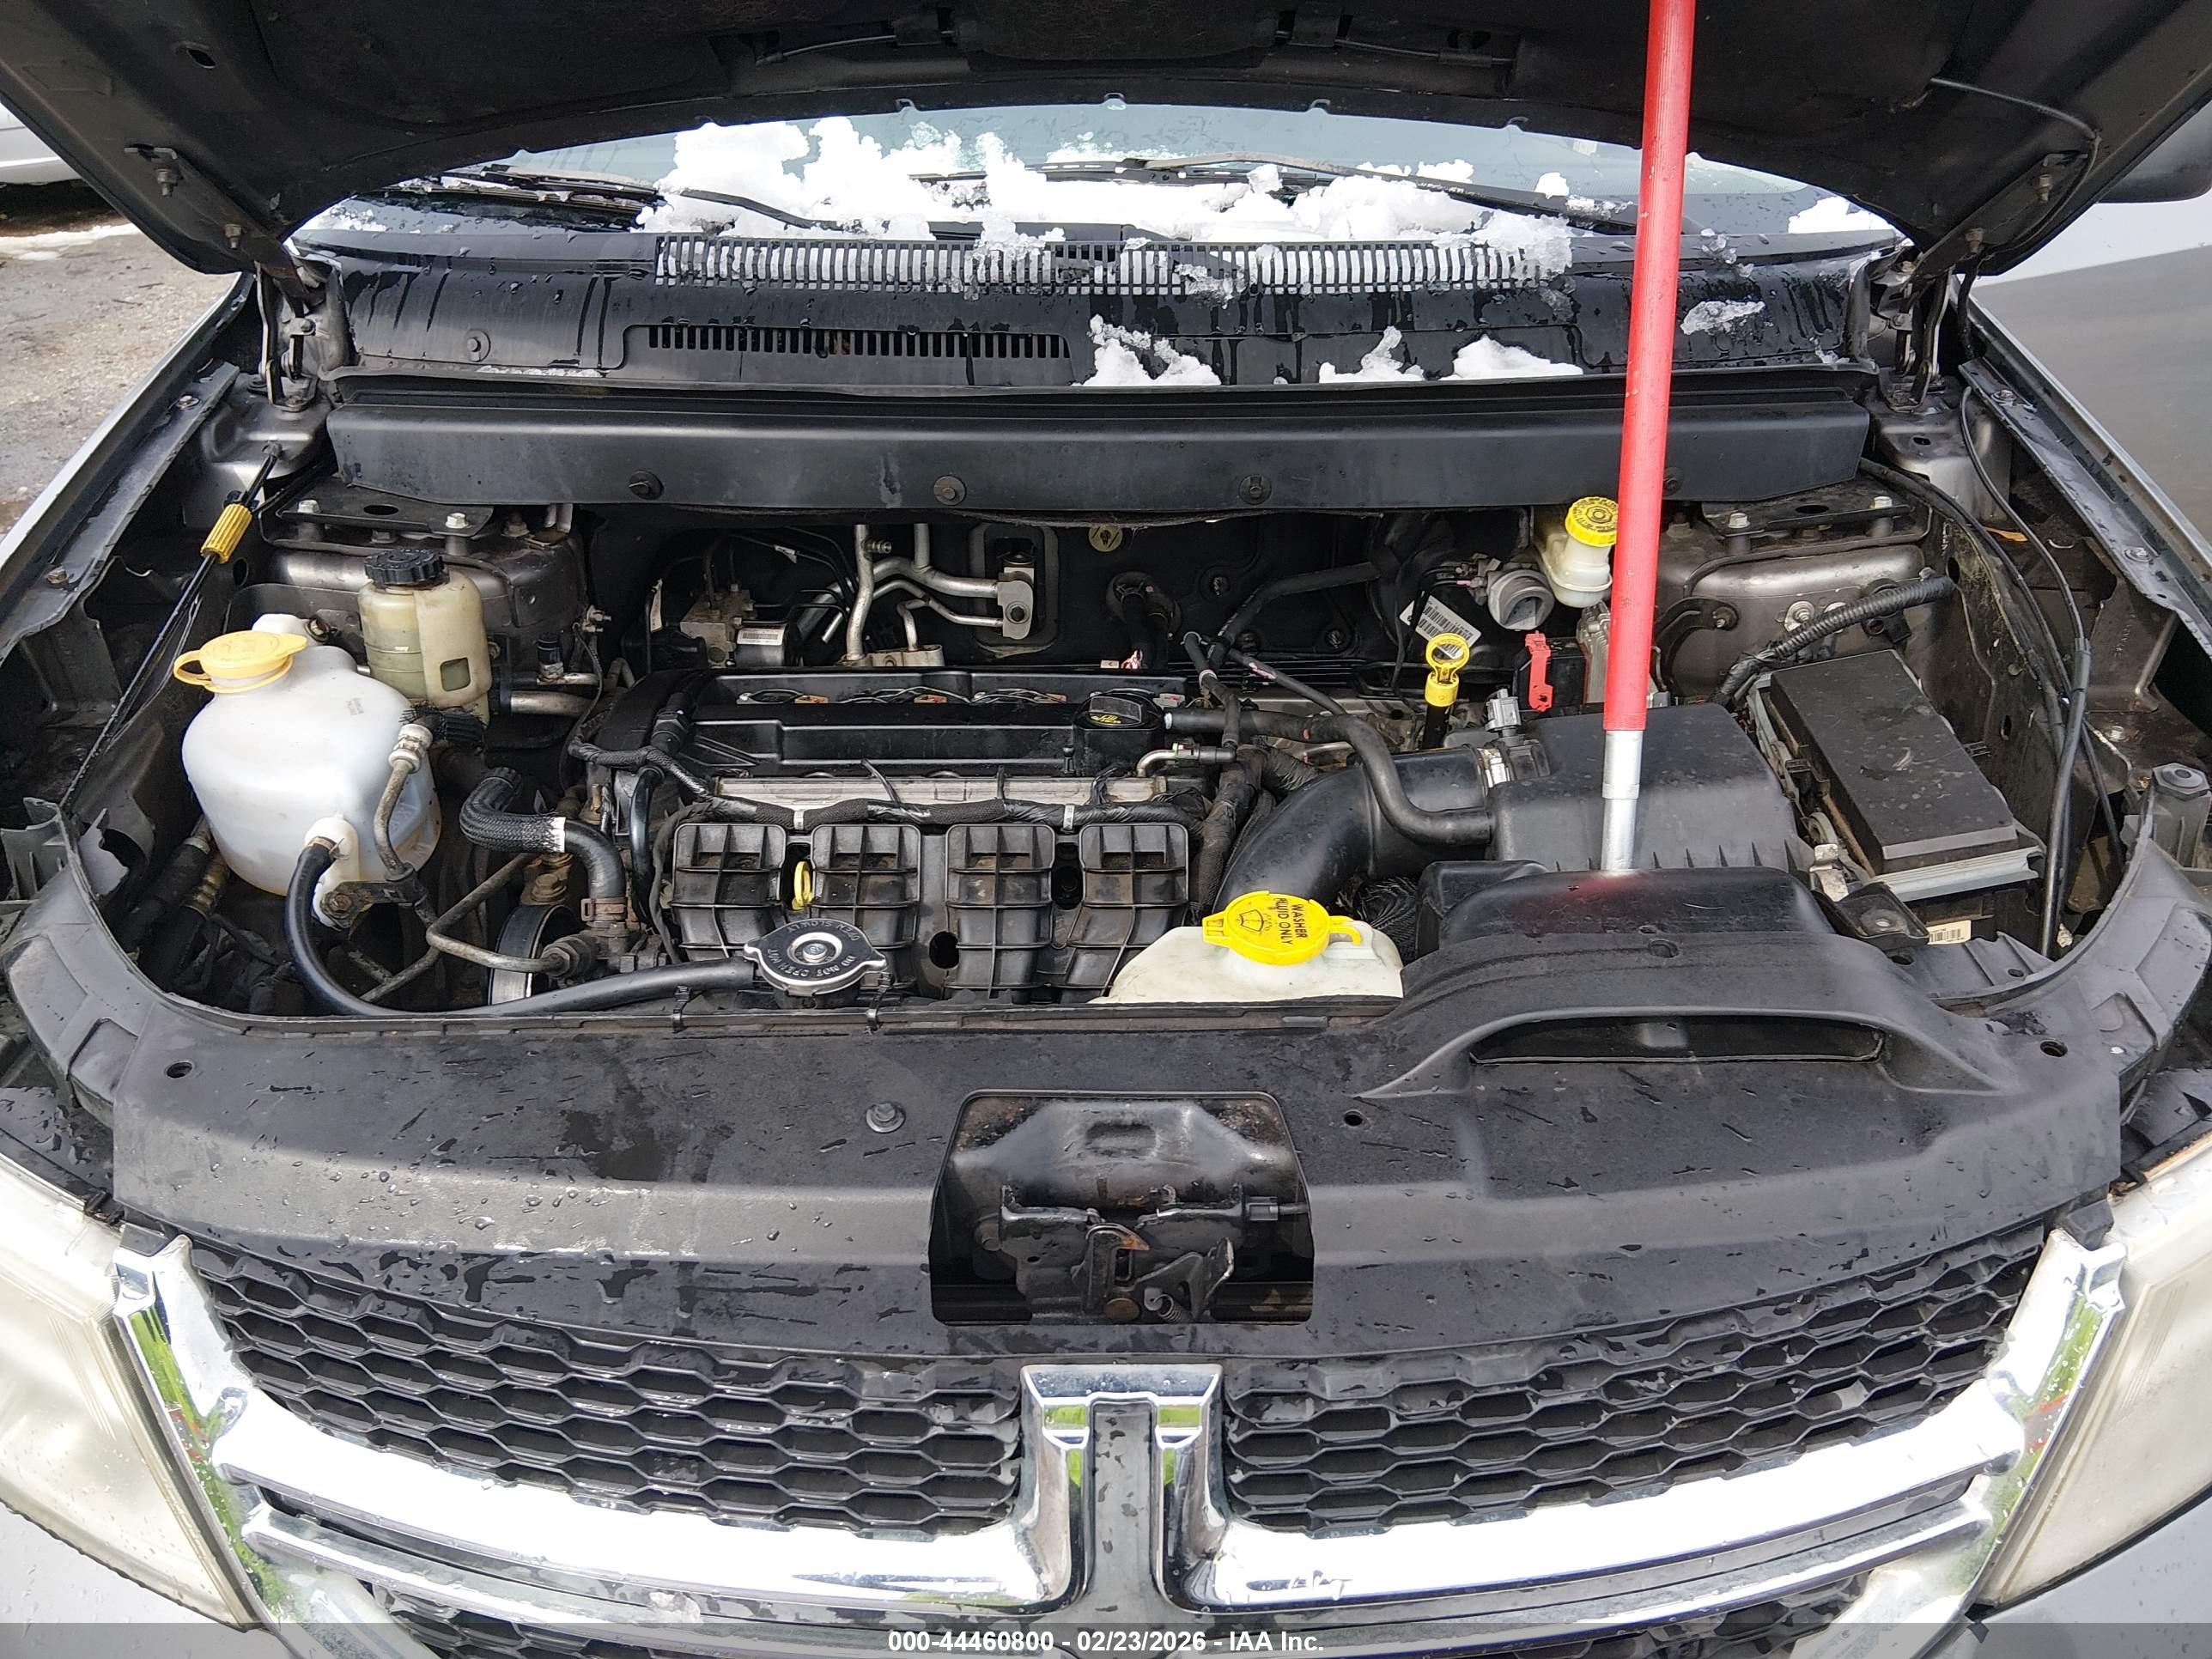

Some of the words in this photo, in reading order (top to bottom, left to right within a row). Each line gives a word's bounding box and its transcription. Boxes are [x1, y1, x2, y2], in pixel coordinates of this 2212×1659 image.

[787, 920, 833, 933] SLOWLY
[1291, 904, 1308, 939] WASHER
[837, 921, 860, 941] OPEN
[1279, 921, 1293, 945] ONLY
[841, 955, 857, 967] DO
[816, 964, 840, 977] NOT
